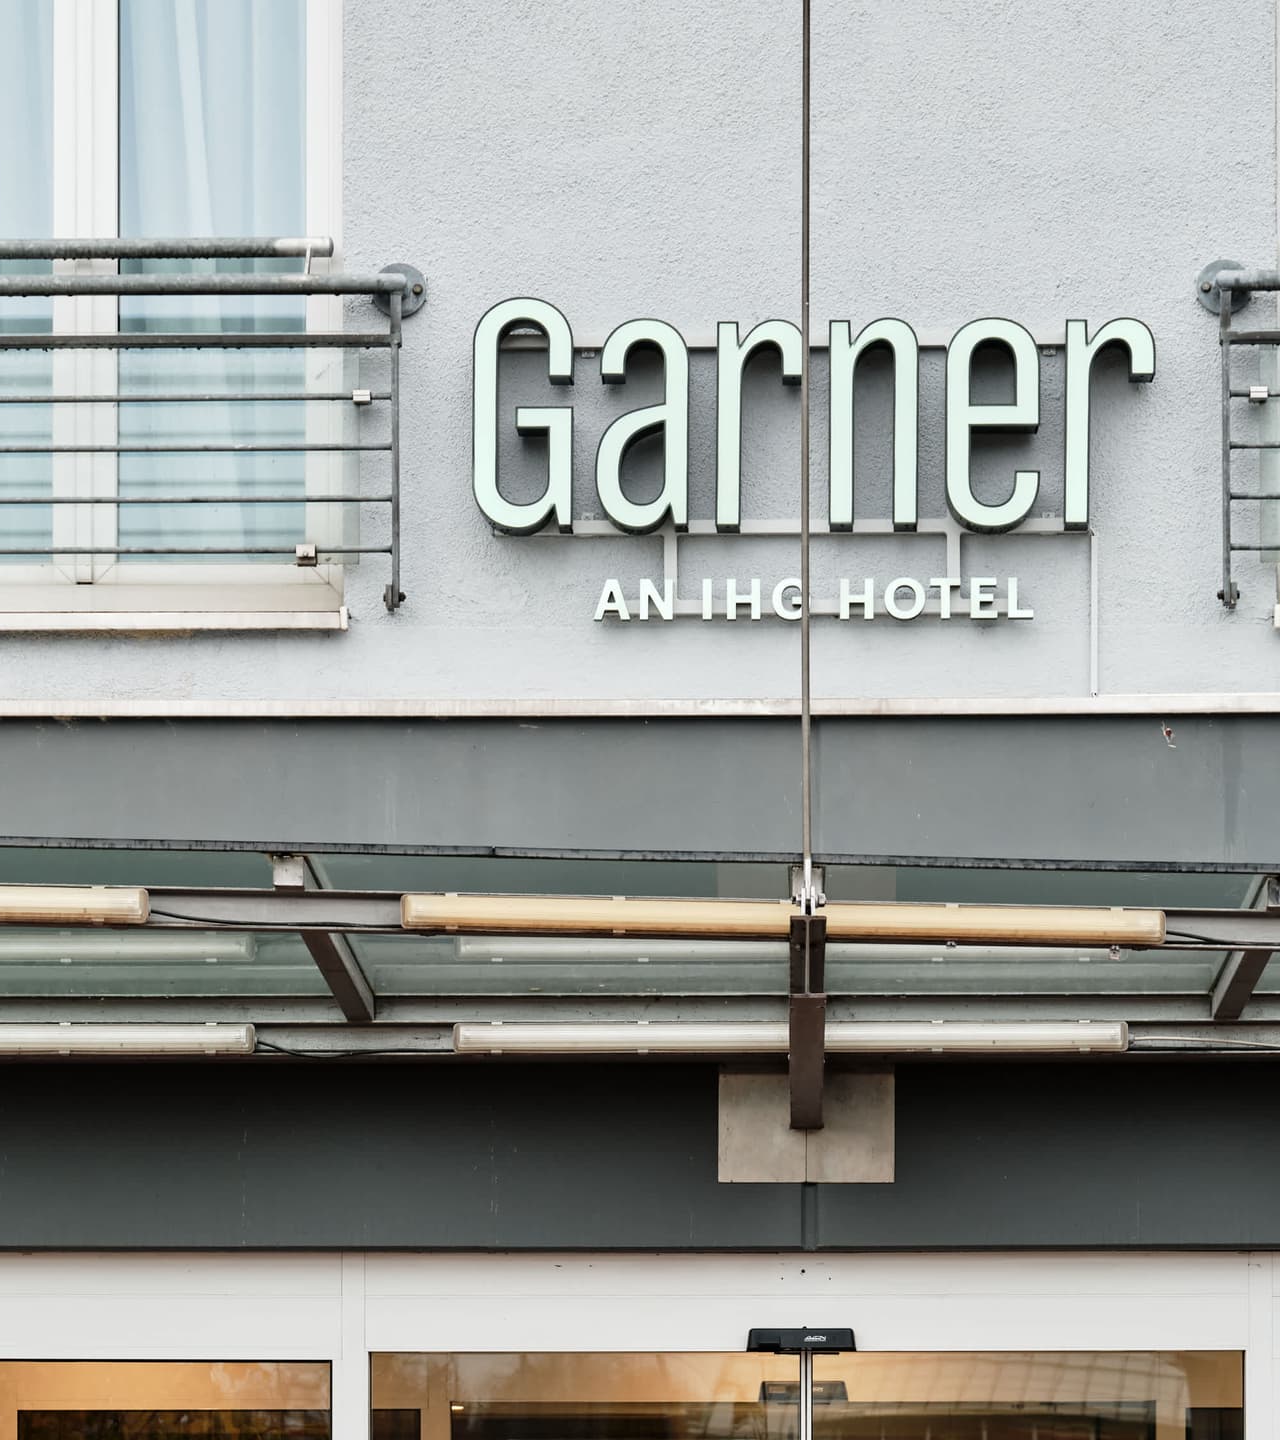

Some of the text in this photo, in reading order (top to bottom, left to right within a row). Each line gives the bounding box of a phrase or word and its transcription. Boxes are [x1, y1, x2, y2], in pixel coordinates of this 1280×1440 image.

[471, 297, 1156, 535] Garner
[593, 577, 1035, 621] AN IHG HOTEL
